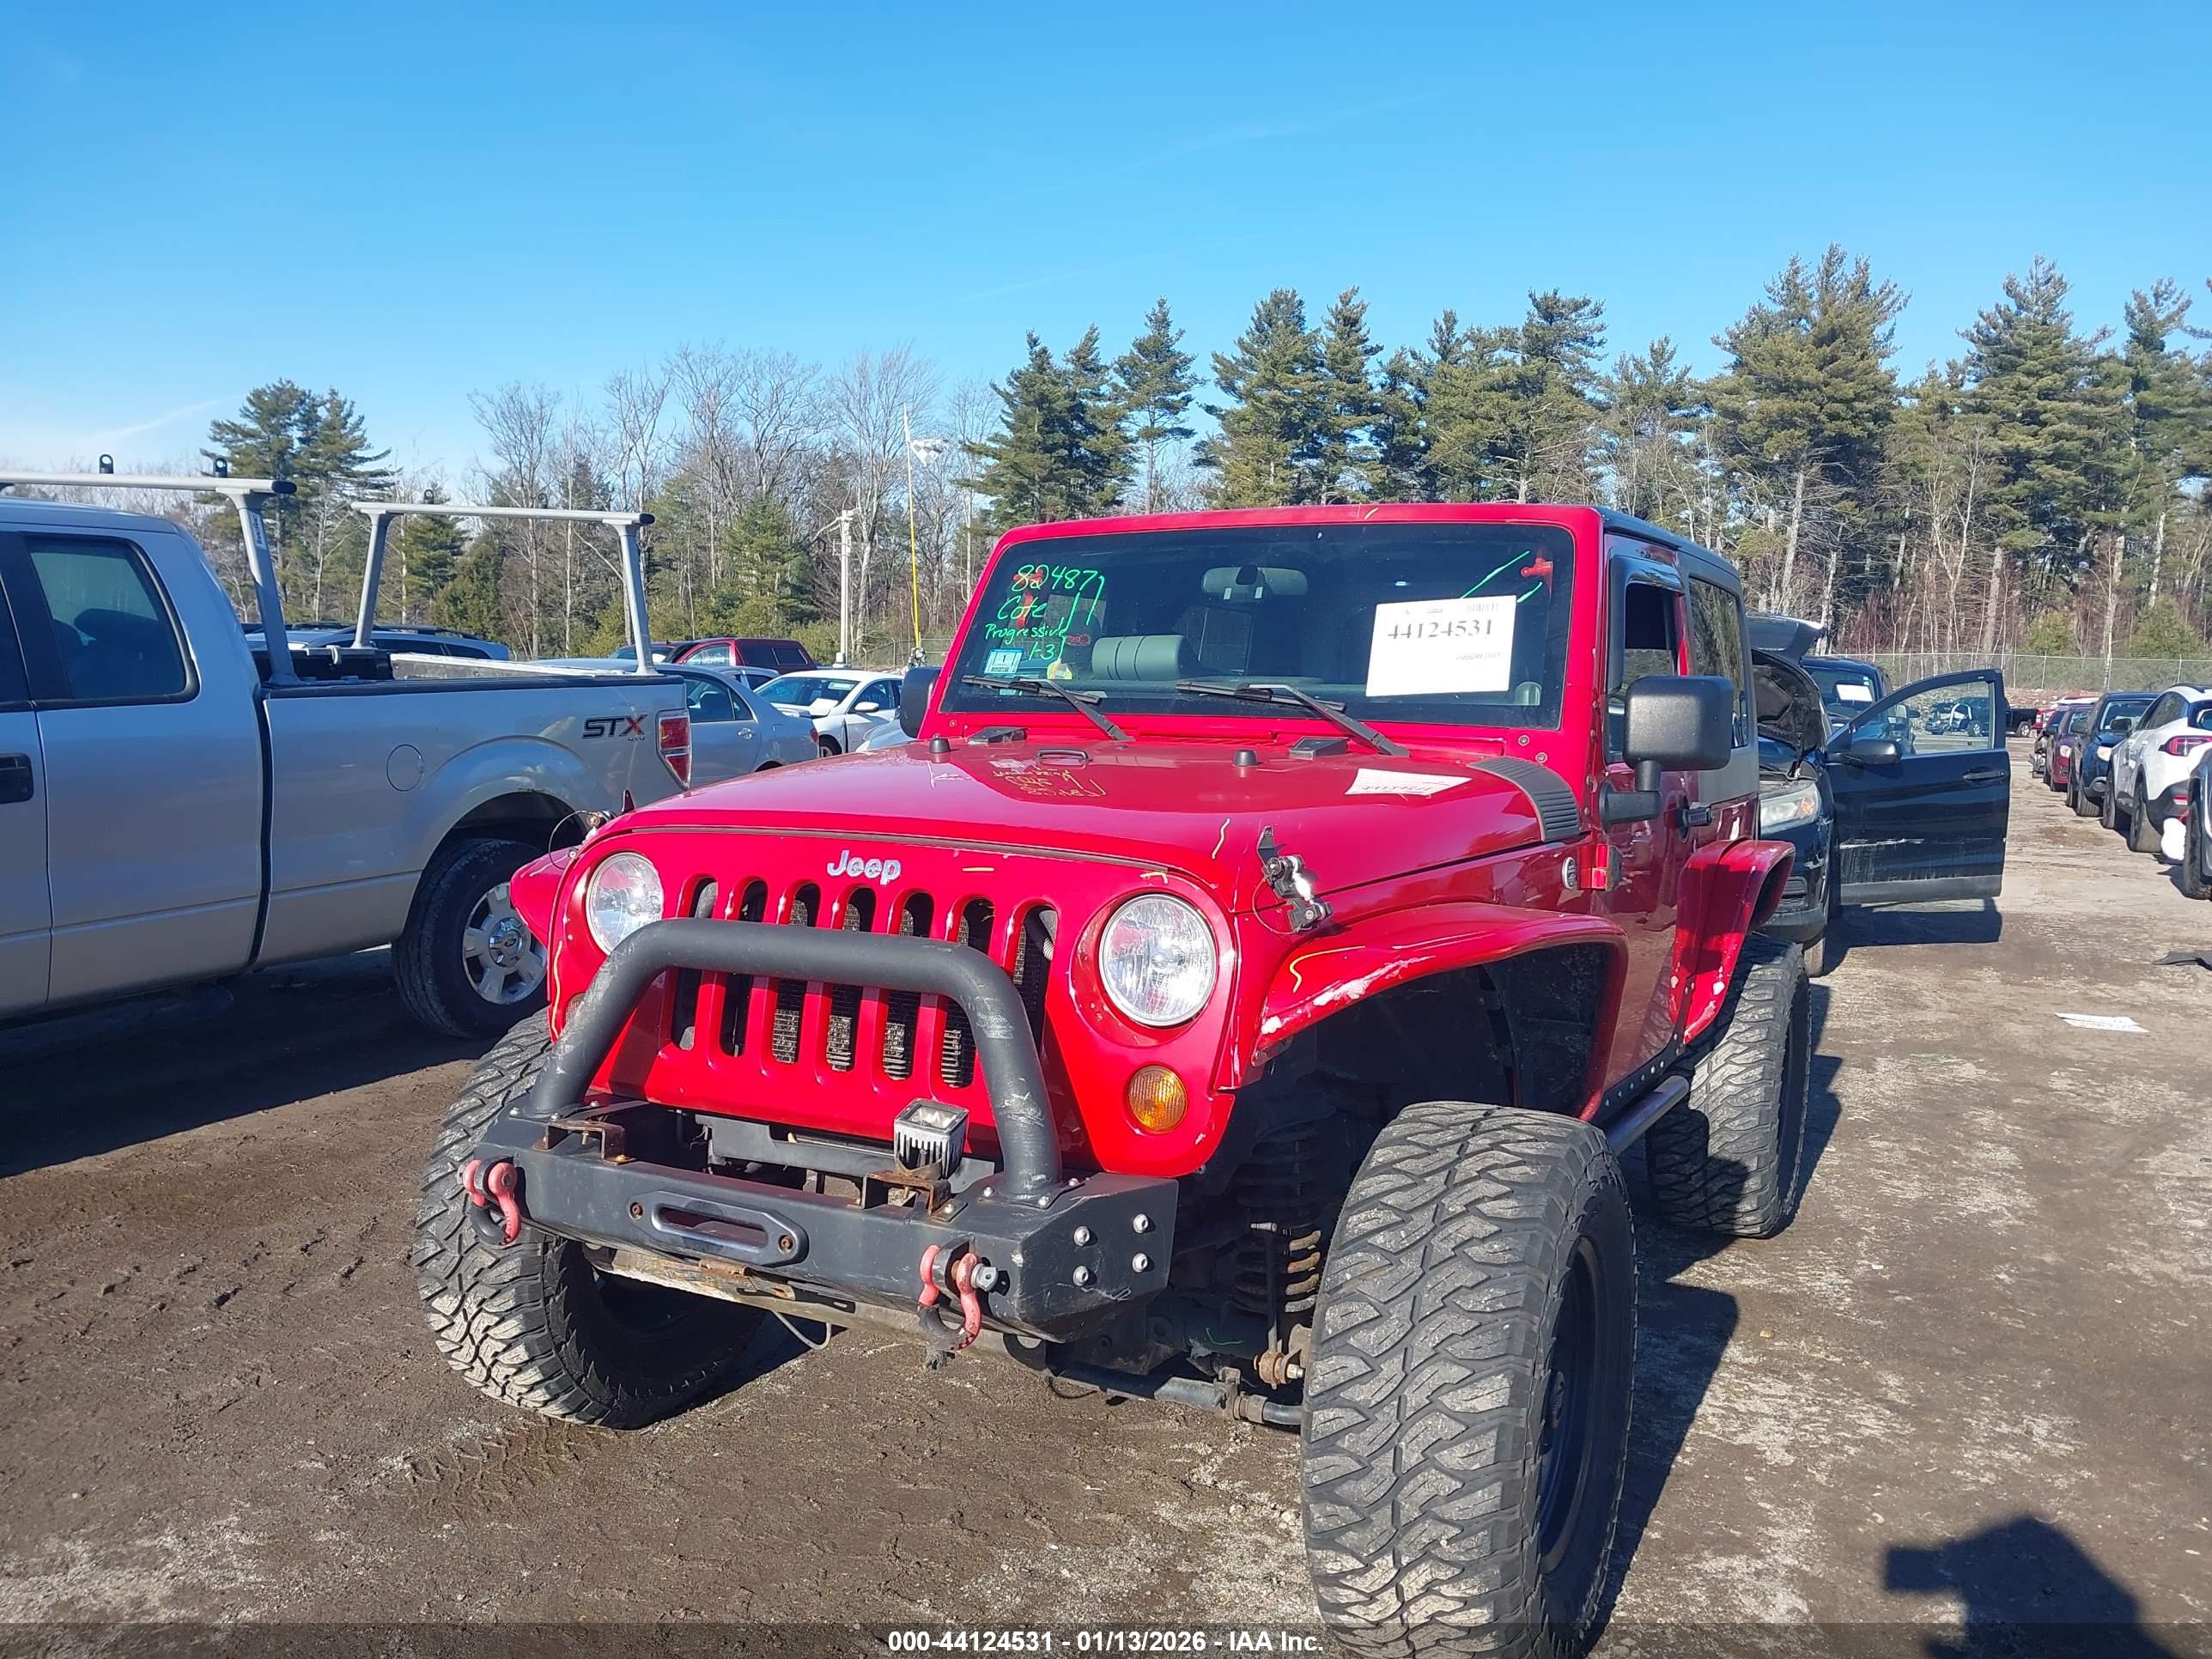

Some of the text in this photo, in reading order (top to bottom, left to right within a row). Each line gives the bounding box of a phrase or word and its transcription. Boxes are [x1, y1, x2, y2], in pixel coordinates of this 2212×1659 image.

[998, 595, 1048, 619] Cote
[1387, 618, 1492, 640] 44124531
[581, 714, 648, 739] STX
[827, 849, 902, 886] Jeep
